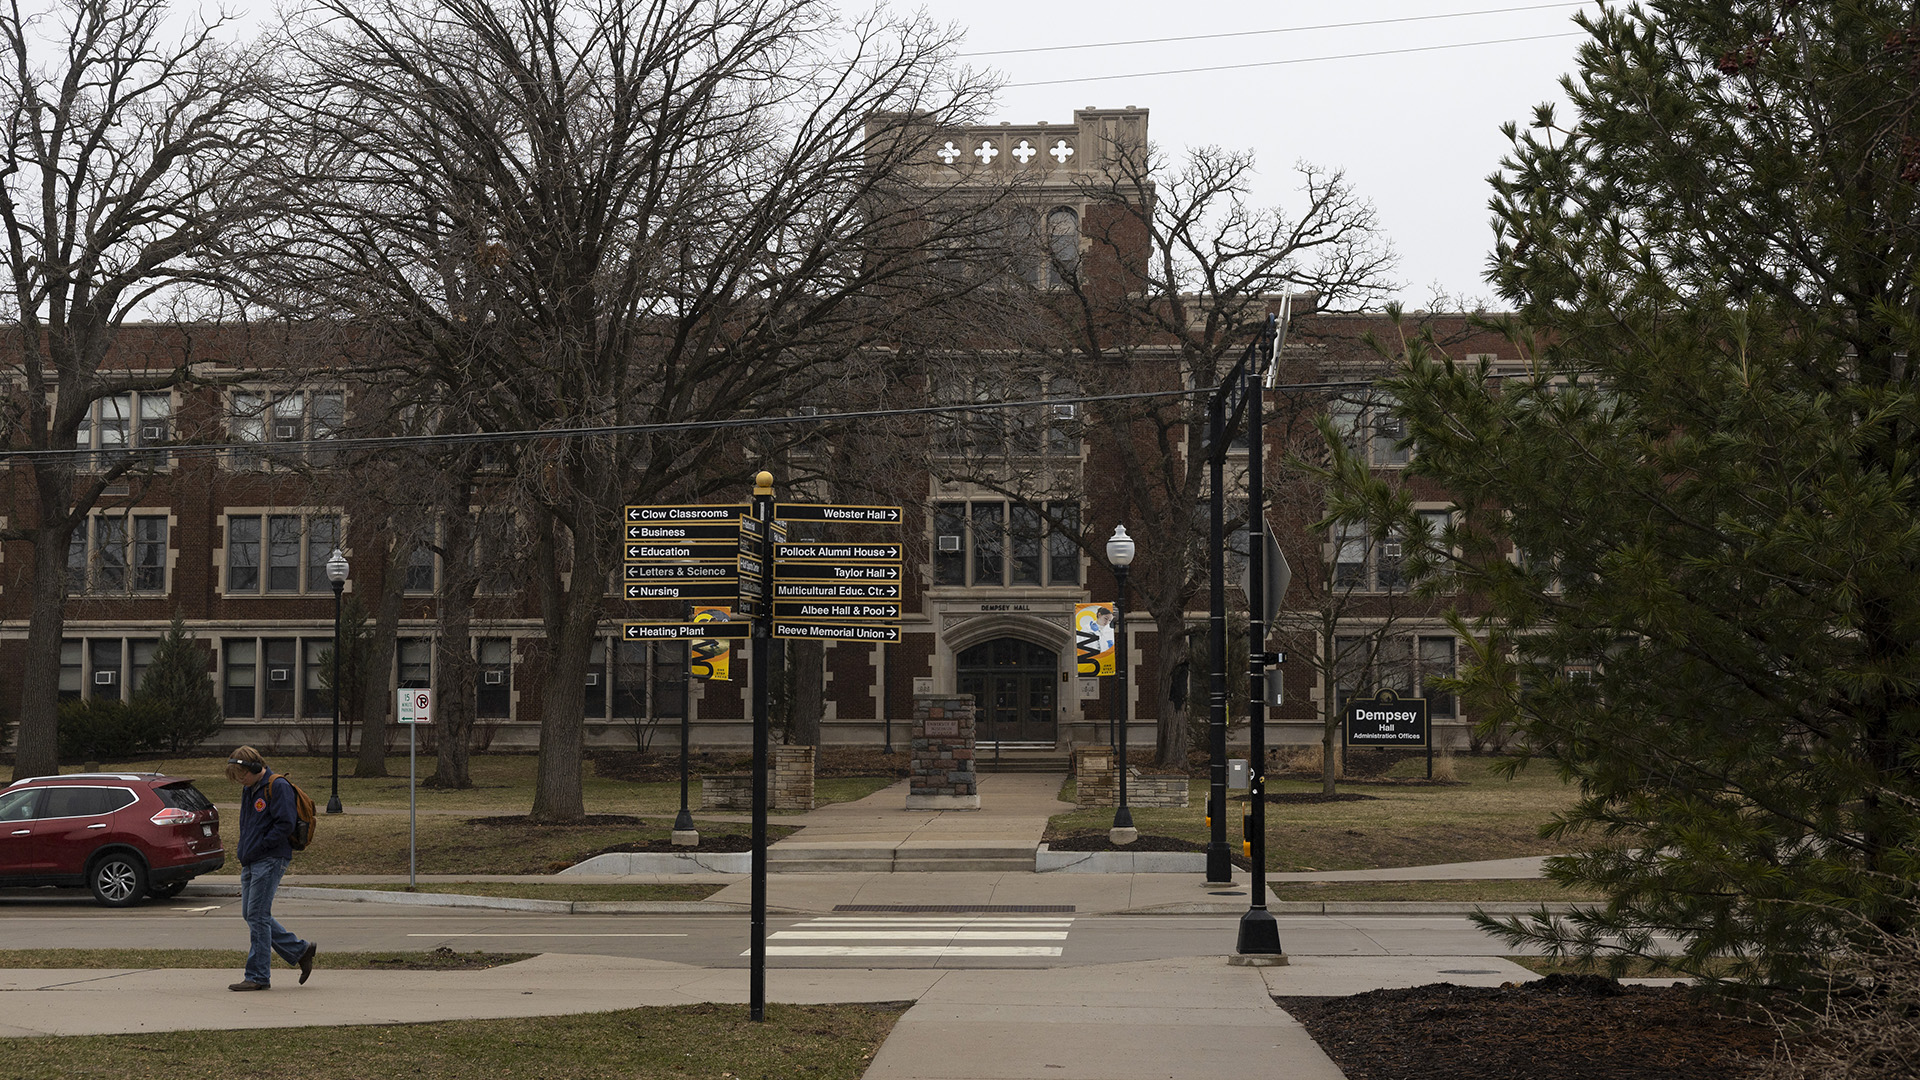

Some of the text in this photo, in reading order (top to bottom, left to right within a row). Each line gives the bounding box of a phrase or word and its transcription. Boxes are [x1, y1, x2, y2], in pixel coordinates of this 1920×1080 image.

[641, 509, 729, 519] Clow Classrooms
[823, 509, 886, 519] Webster Hall
[641, 527, 686, 537] Business
[640, 547, 690, 556] Education
[780, 547, 885, 557] Pollock Alumni House
[639, 566, 726, 576] Letters & Science
[834, 567, 885, 579] Taylor Hall
[640, 587, 679, 597] Nursing
[778, 586, 885, 596] Multicultural Educ. Ctr.
[801, 605, 884, 615] Albee Hall & Pool
[639, 626, 705, 638] Heating Plant
[778, 625, 885, 638] Reeve Memorial Union
[404, 693, 410, 701] 15
[1356, 709, 1416, 723] Dempsey
[1379, 724, 1395, 732] Hall
